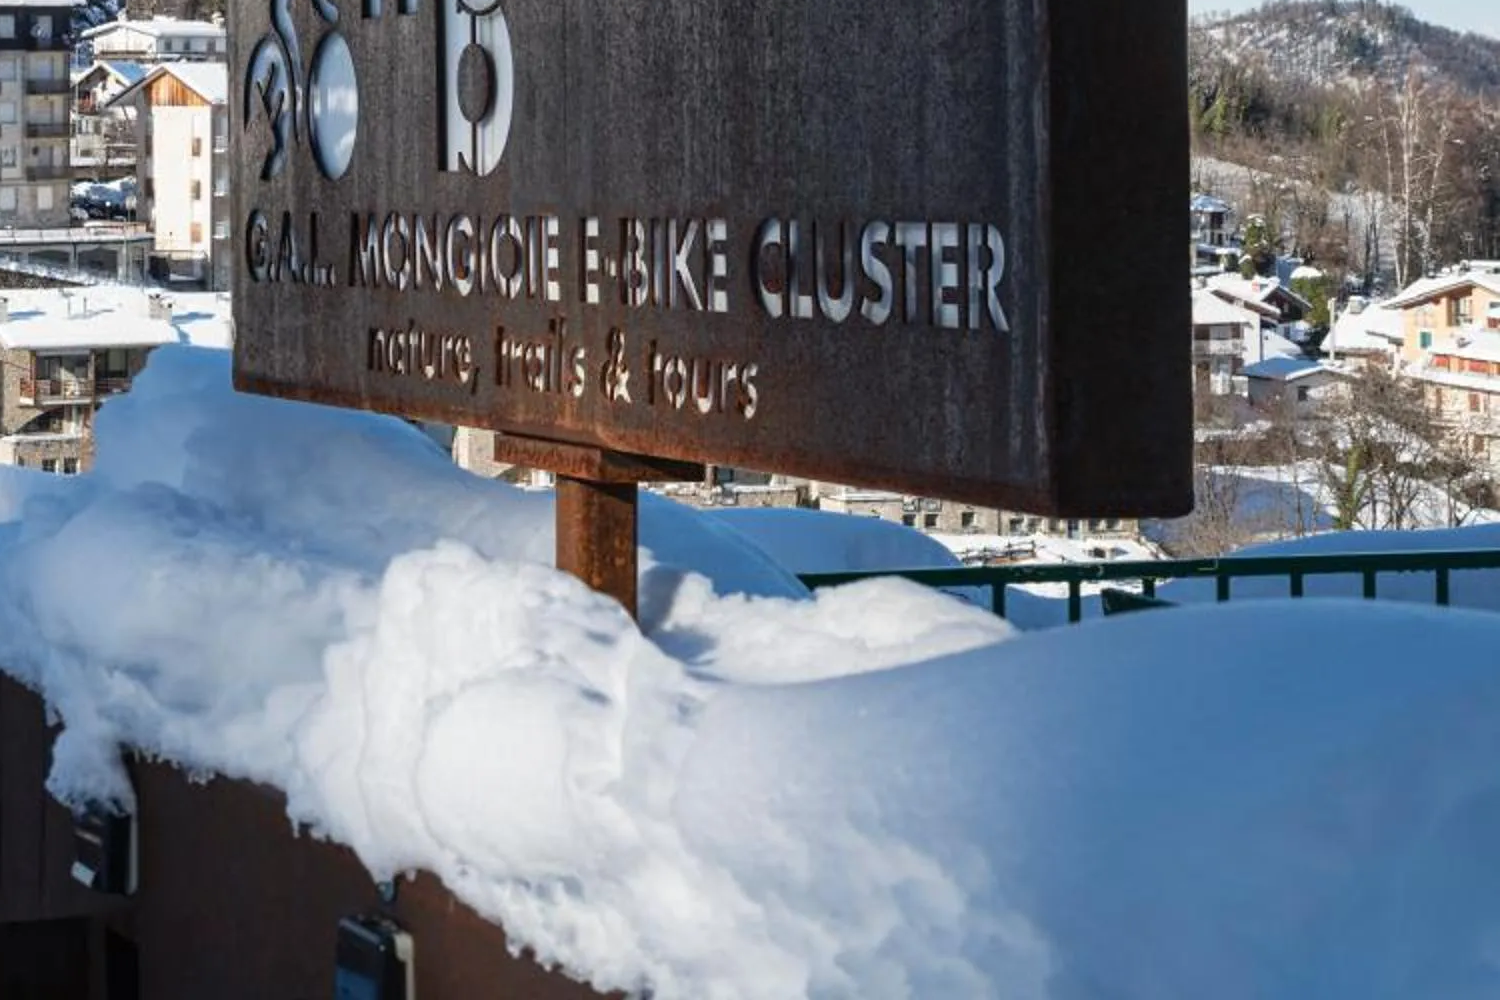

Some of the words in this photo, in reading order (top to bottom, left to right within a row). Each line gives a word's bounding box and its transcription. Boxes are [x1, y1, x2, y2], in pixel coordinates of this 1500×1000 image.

[245, 208, 337, 287] G.A.L.
[349, 211, 561, 301] MONGIOIE
[579, 216, 728, 313] E-BIKE
[751, 217, 1010, 333] CLUSTER
[367, 317, 479, 396] nature,
[495, 315, 586, 399] trails
[602, 326, 632, 405] &
[649, 339, 758, 420] tours
